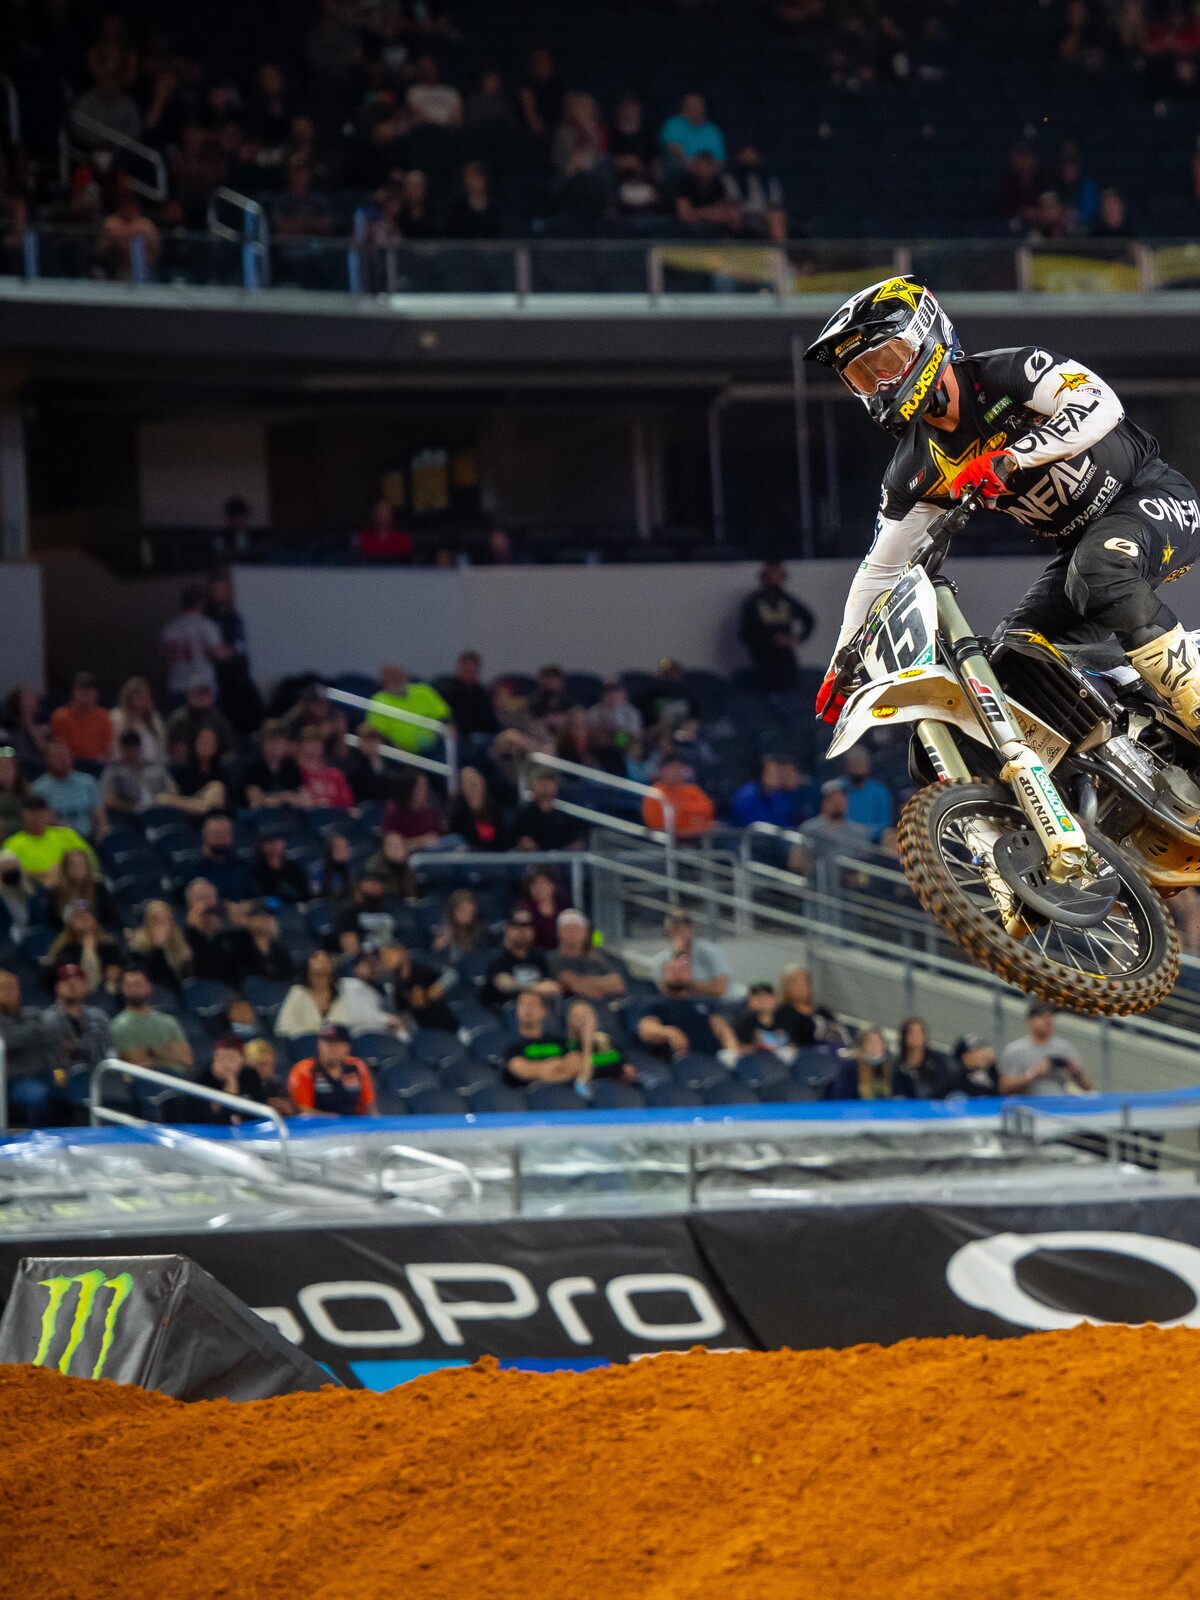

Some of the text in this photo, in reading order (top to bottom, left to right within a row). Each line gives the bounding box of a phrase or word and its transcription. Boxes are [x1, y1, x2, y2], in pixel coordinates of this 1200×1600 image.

[900, 343, 946, 421] ROCKSTAR
[1004, 455, 1091, 526] NEAL
[1072, 478, 1089, 500] ENJOY
[1086, 463, 1097, 482] RIDE
[875, 588, 928, 674] 15
[1019, 776, 1057, 838] DUNLOP
[1034, 768, 1066, 818] MOTOREX
